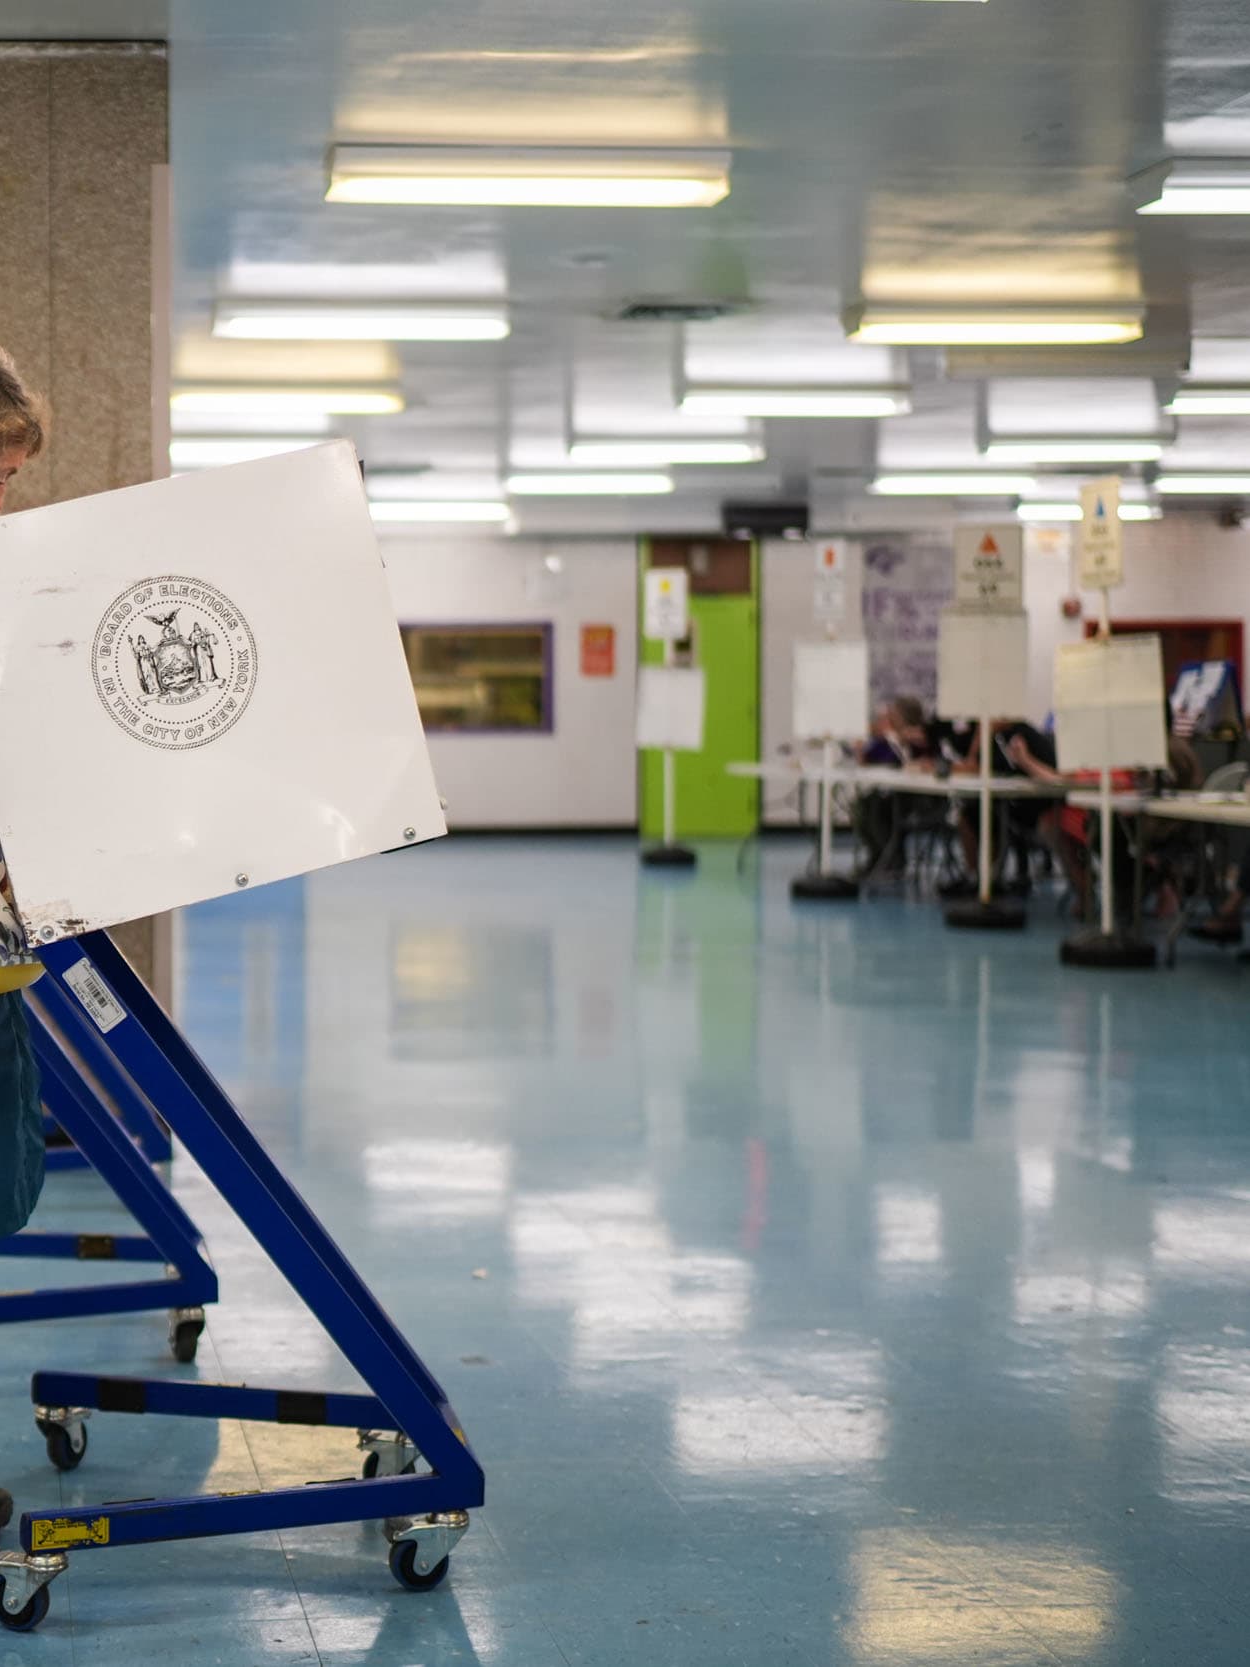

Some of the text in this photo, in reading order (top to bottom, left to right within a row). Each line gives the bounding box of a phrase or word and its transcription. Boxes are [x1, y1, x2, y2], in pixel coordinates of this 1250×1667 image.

[100, 584, 239, 656] BOARD OF ELECTIONS
[102, 648, 250, 741] IN THE CITY OF NEW YORK
